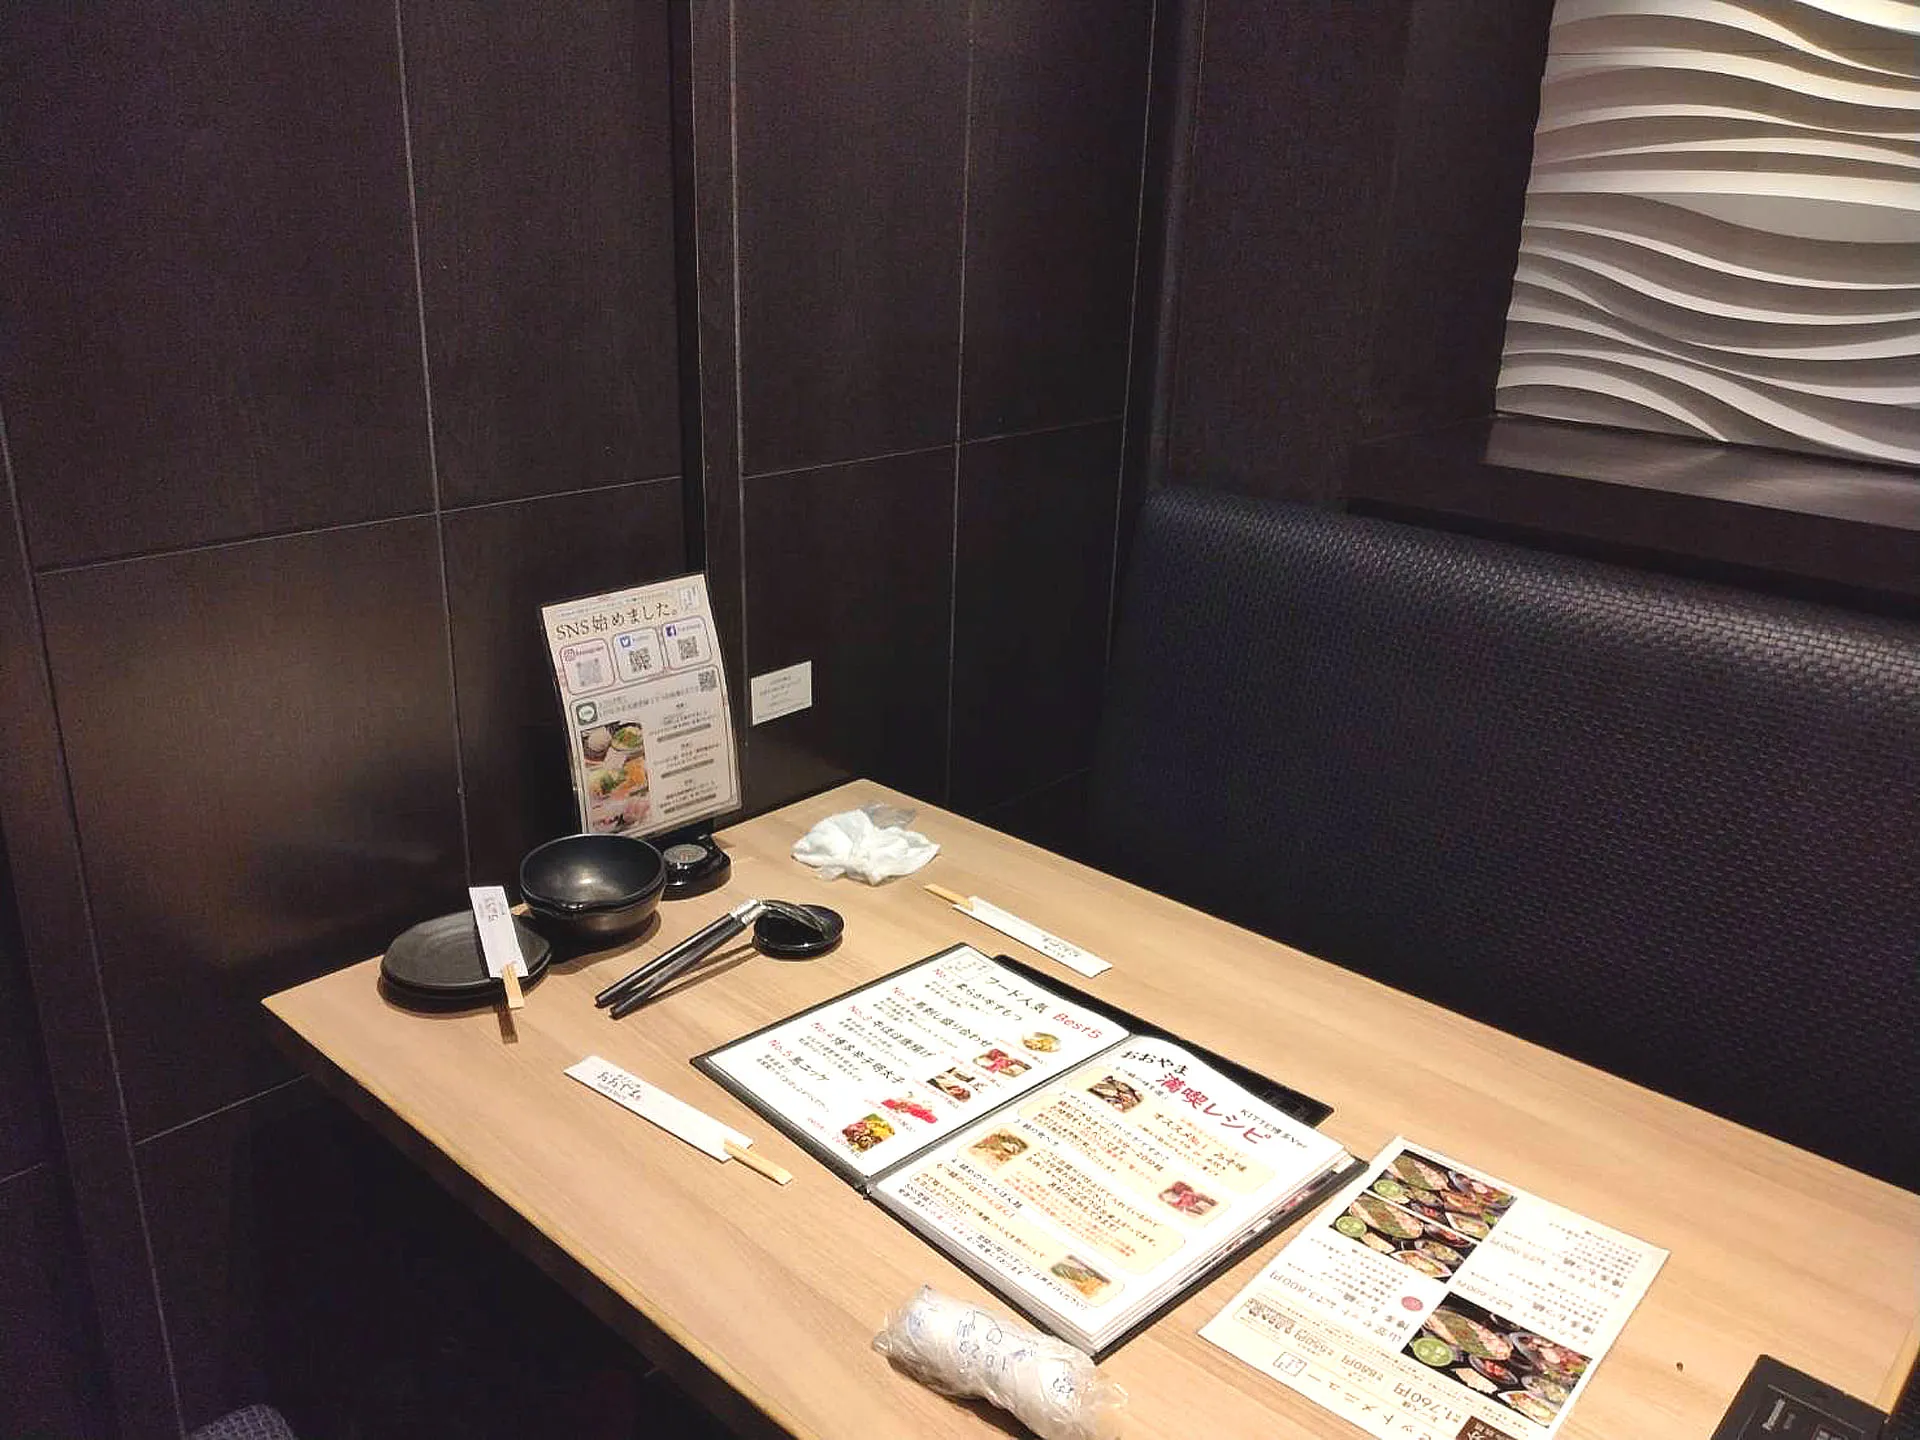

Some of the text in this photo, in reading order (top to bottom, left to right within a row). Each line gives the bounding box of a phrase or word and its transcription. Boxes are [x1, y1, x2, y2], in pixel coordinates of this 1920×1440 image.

[555, 602, 677, 640] SNS始めました。
[1121, 1051, 1189, 1076] おおやま
[1156, 1072, 1271, 1144] 満喫レシピ
